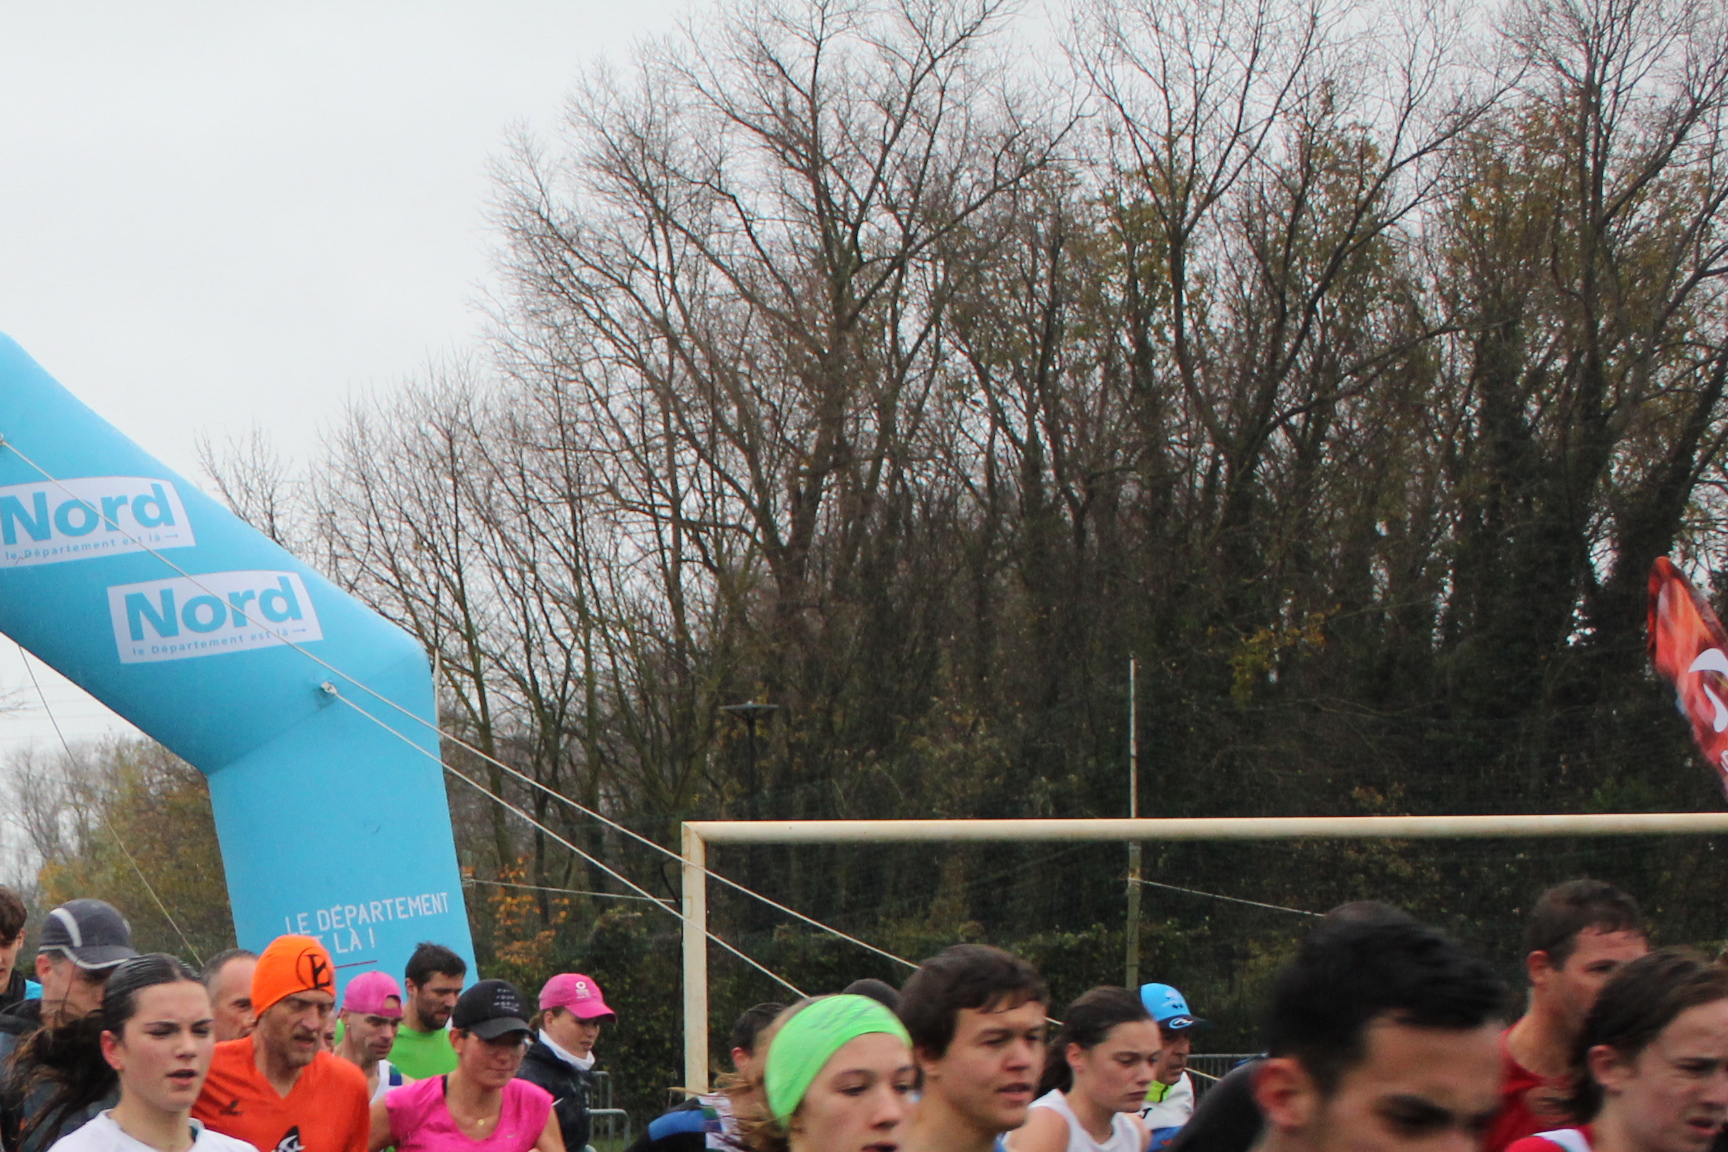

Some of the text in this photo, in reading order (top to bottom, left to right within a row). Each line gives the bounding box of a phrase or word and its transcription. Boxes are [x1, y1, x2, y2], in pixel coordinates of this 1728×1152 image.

[4, 549, 19, 562] le
[23, 537, 117, 561] Département
[148, 530, 162, 543] là
[125, 577, 303, 641] Nord
[130, 645, 145, 657] le
[150, 633, 244, 660] Département
[285, 892, 450, 936] LE DÉPARTEMENT
[333, 927, 363, 954] LÀ
